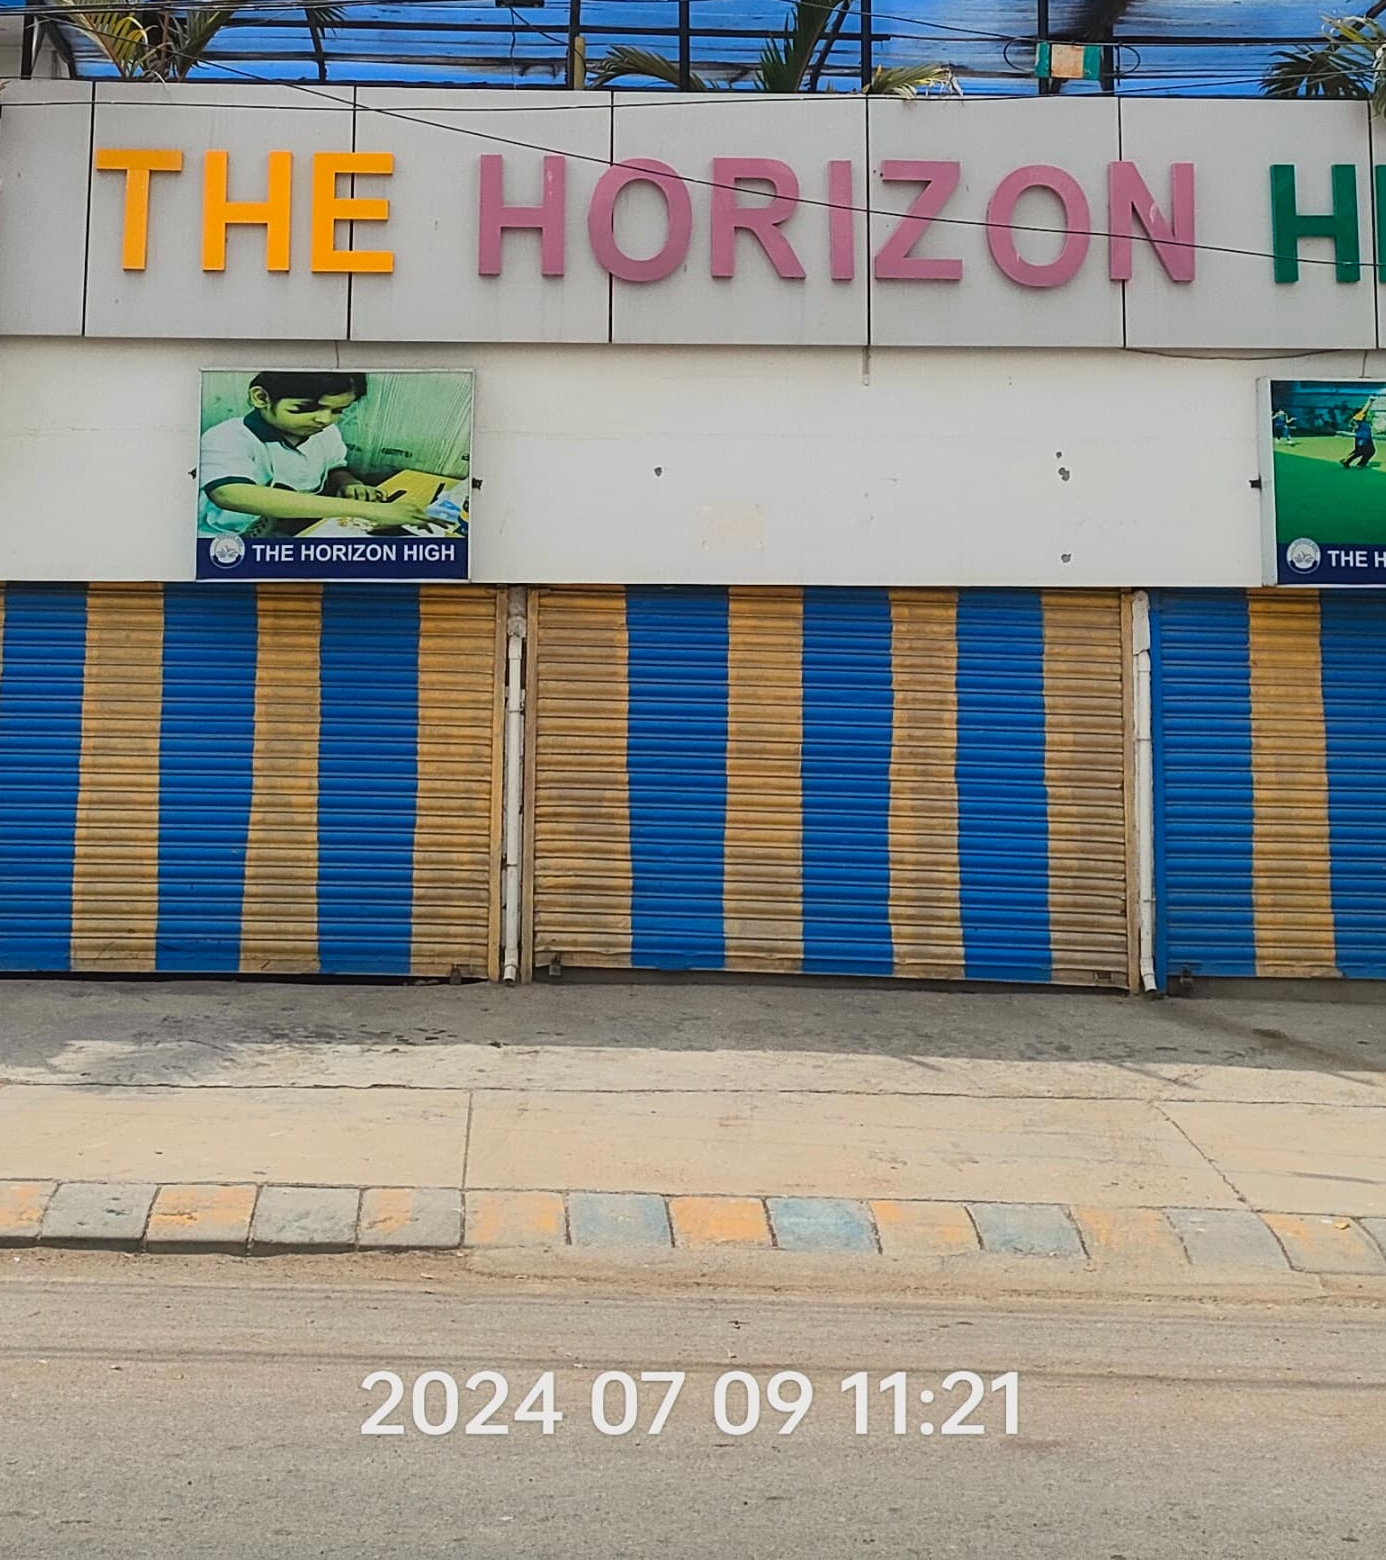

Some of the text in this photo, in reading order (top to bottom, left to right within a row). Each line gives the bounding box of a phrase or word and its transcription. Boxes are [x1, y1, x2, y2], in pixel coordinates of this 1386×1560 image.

[96, 148, 395, 273] THE
[477, 154, 1195, 288] HORIZON
[252, 544, 455, 562] THE HORIZON HIGH
[1327, 549, 1368, 567] THE
